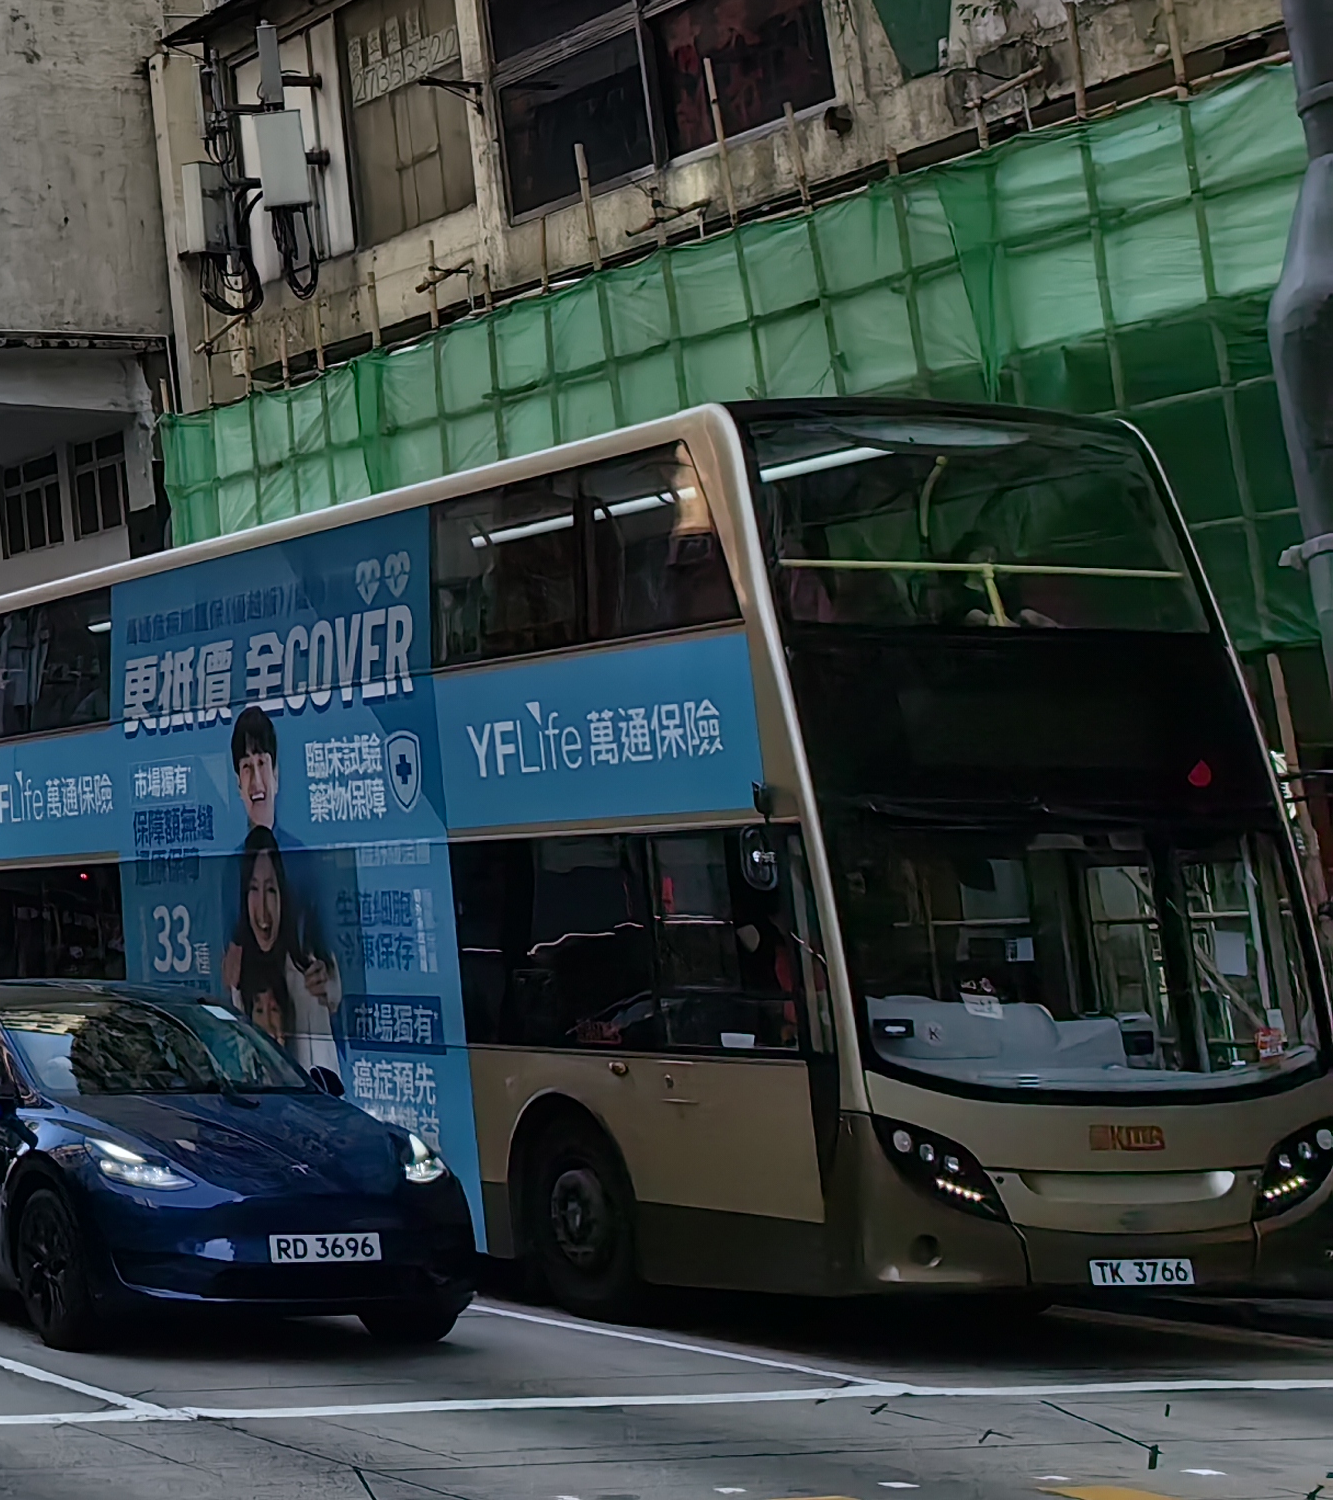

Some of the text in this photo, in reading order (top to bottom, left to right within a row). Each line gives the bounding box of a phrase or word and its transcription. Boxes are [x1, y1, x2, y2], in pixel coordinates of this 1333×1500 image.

[124, 638, 233, 734] 更抵價
[586, 698, 724, 766] 萬通保險
[304, 733, 383, 779] 臨床試驗
[45, 773, 113, 819] 萬通保險
[308, 777, 387, 823] 藥物保障
[153, 905, 192, 973] 33
[352, 1057, 437, 1104] 癌症預先
[276, 1236, 375, 1259] RD 3696
[1095, 1261, 1189, 1283] TK 3766
